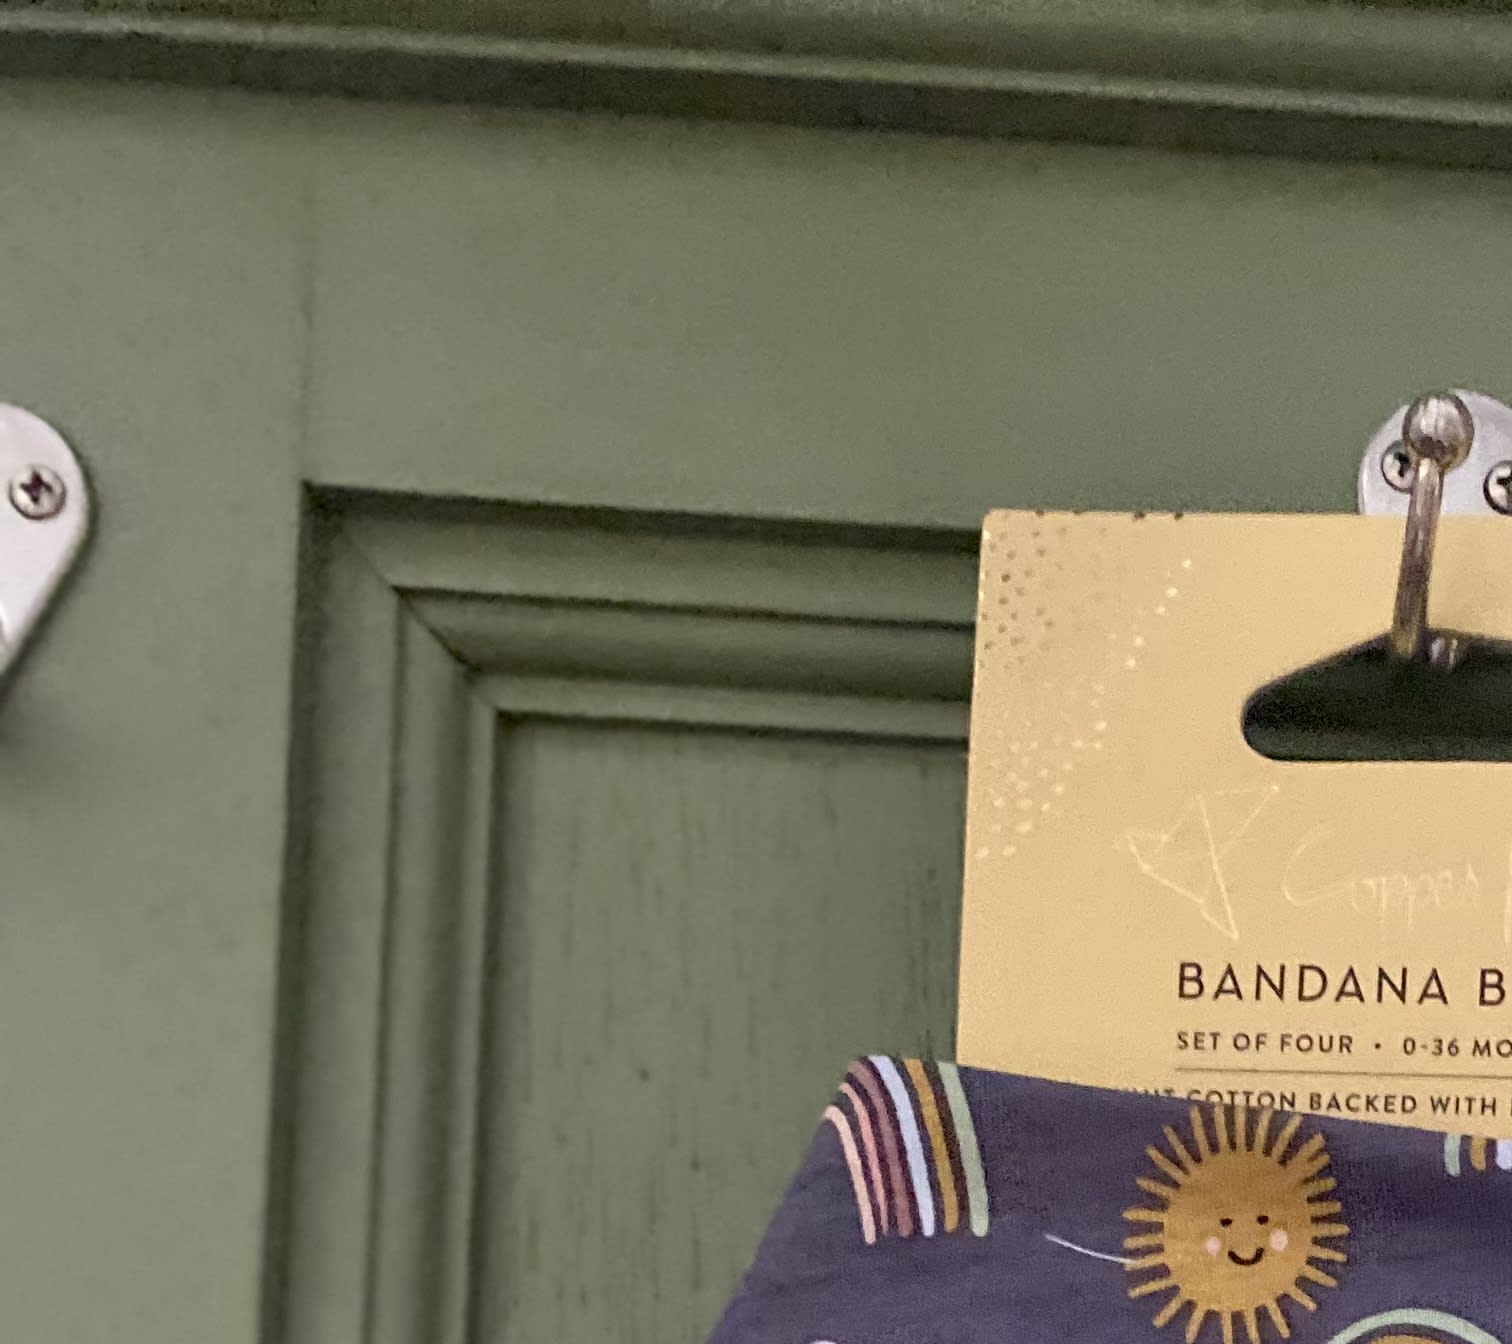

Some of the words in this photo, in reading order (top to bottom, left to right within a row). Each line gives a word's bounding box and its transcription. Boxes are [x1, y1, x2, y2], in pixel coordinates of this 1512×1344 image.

[1177, 961, 1449, 1007] BANDANA
[1176, 1031, 1221, 1052] SET
[1232, 1032, 1268, 1053] OF
[1279, 1033, 1354, 1055] FOUR
[1402, 1037, 1461, 1057] 0-36
[1309, 1091, 1418, 1114] BACKED
[1430, 1095, 1498, 1117] WITH
